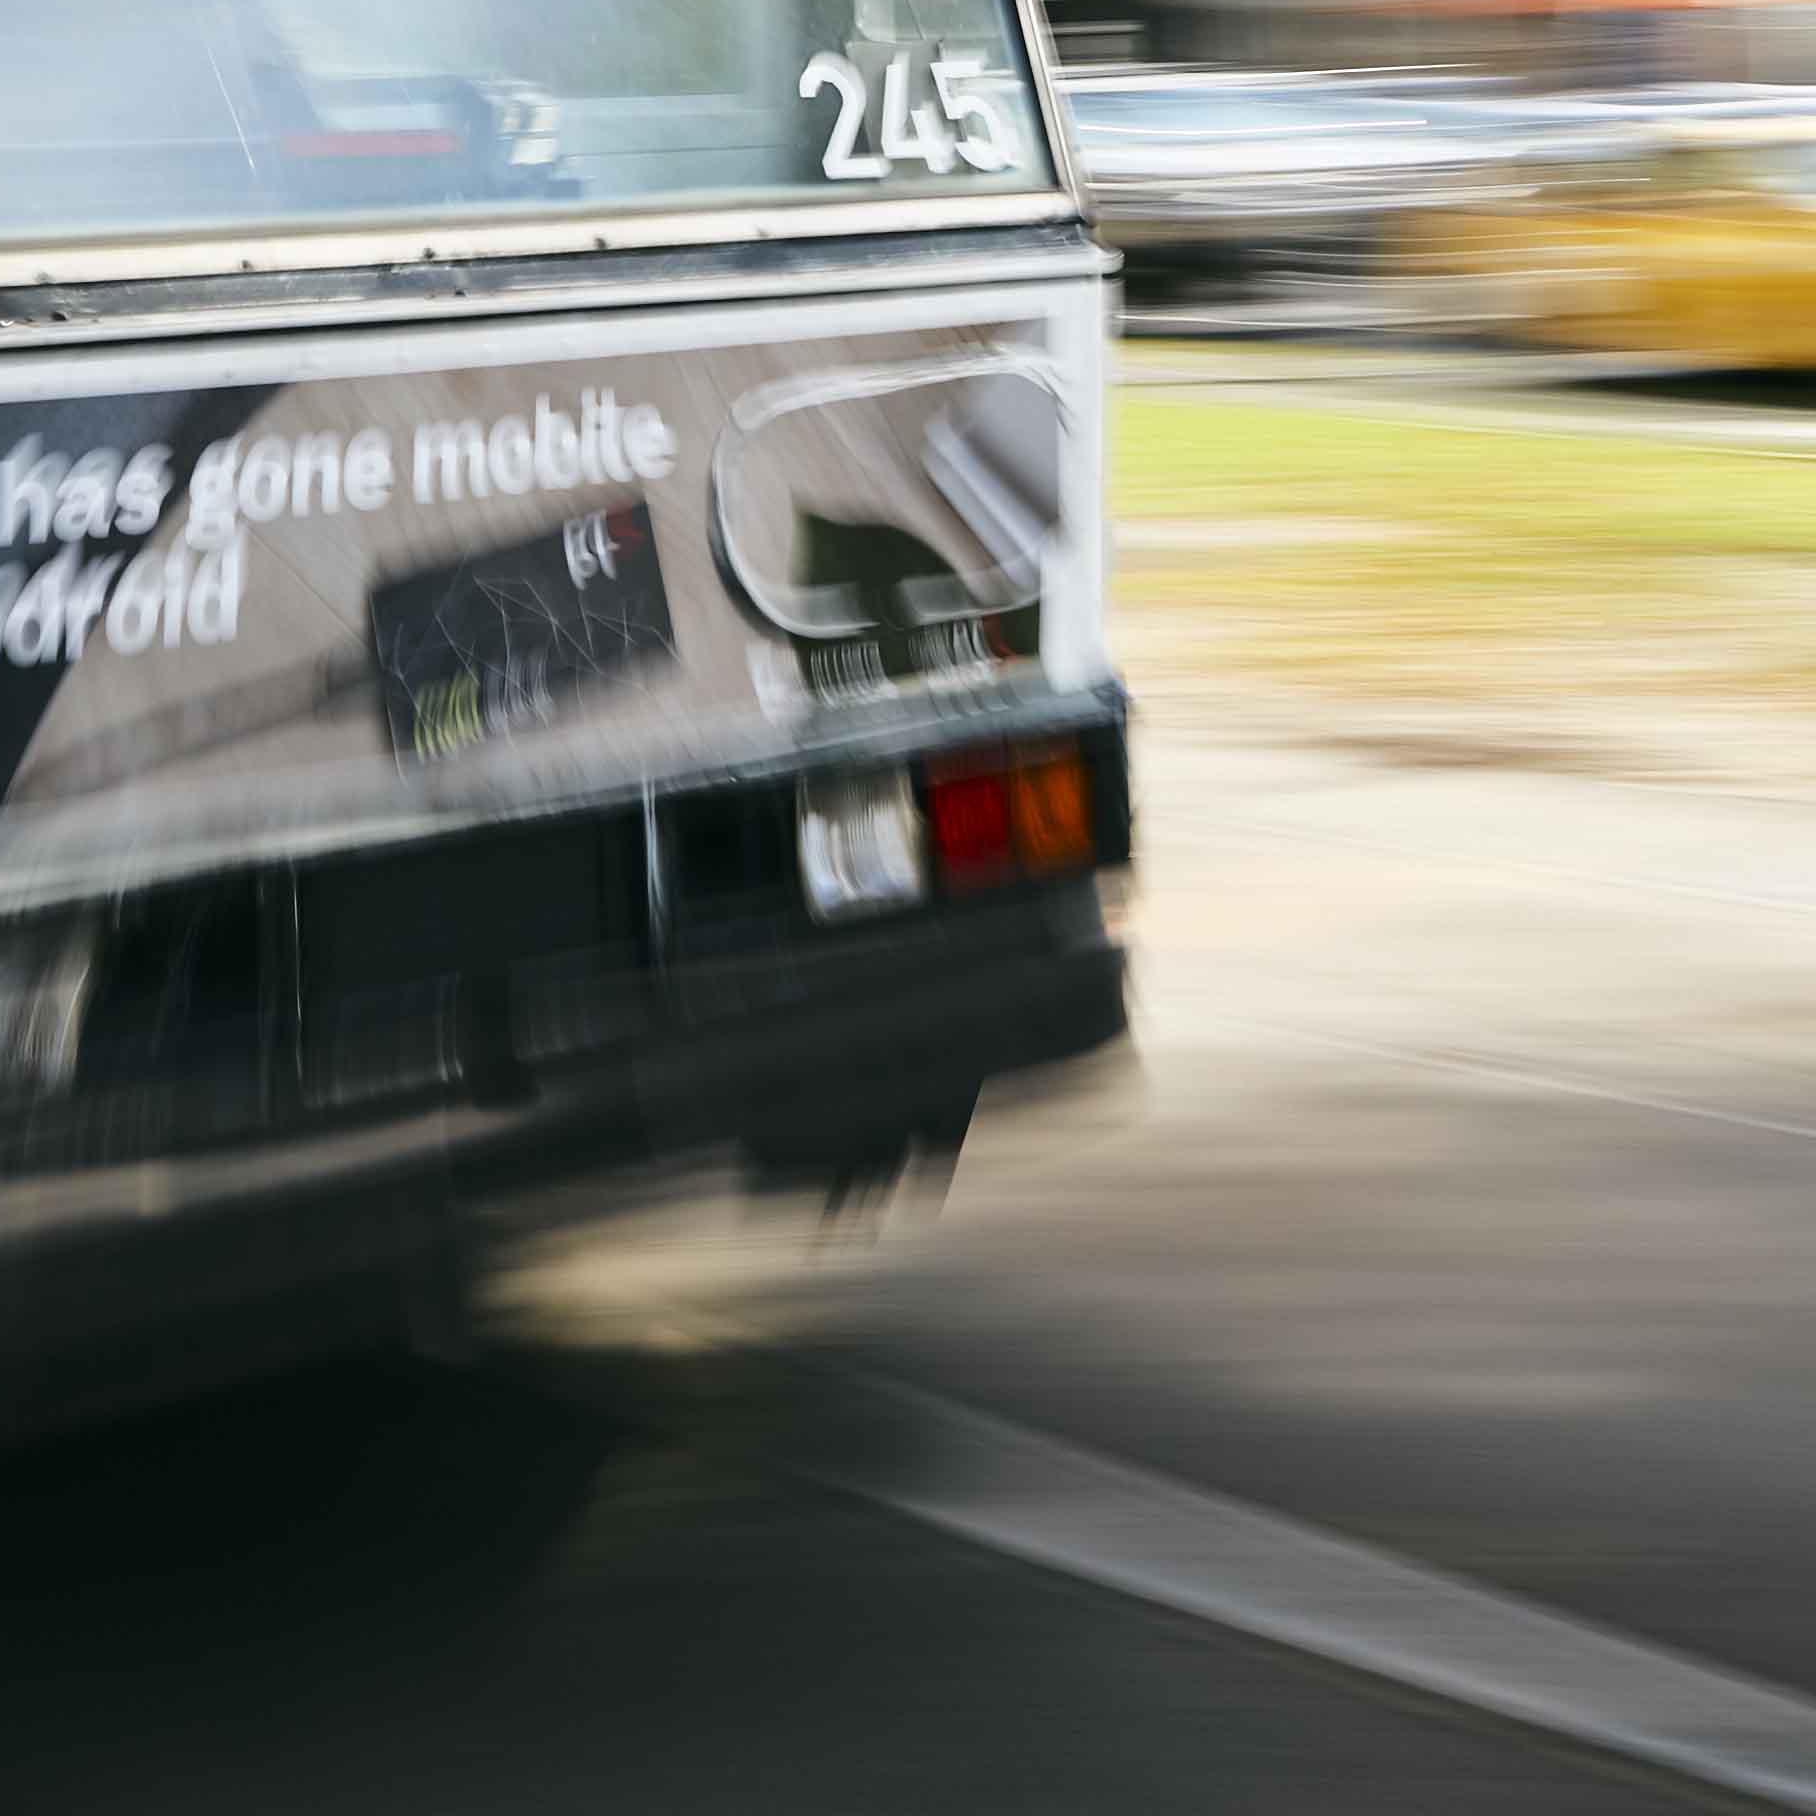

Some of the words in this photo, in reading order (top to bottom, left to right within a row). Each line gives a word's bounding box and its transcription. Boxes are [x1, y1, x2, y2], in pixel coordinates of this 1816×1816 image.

[797, 50, 1026, 182] 245
[185, 429, 392, 551] gone
[412, 388, 679, 506] mobile
